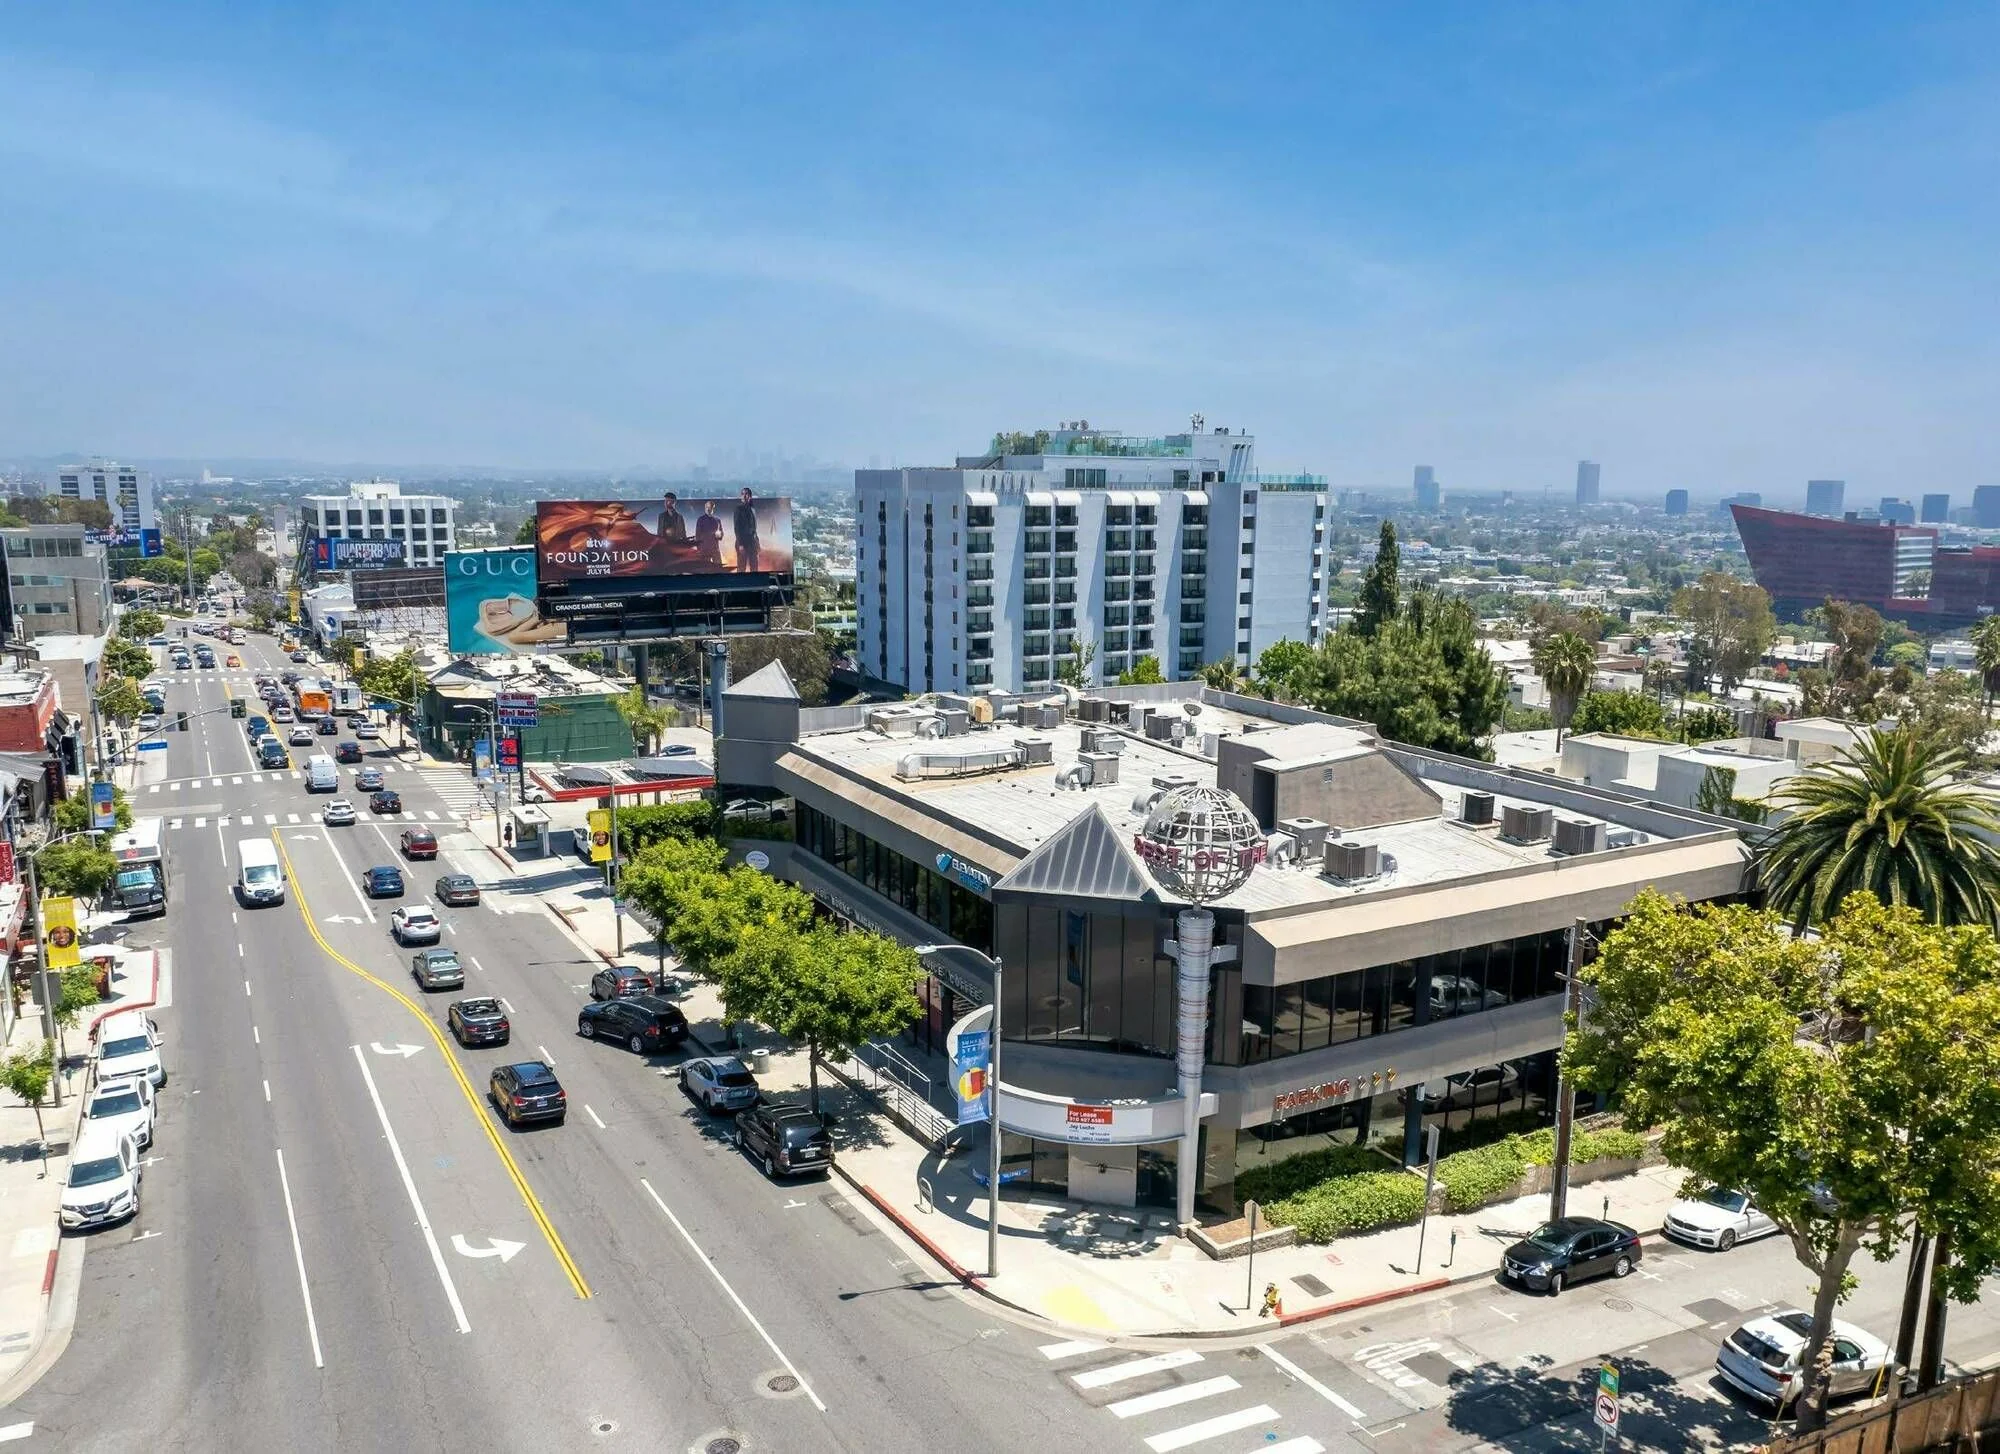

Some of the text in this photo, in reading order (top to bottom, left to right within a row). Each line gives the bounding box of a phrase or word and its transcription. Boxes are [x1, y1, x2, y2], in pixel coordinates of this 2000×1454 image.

[336, 543, 402, 560] QUARTERBACK
[547, 550, 649, 563] FOUNDATION
[603, 567, 611, 575] 14
[555, 604, 581, 612] ORANGE
[517, 709, 537, 718] Mart
[511, 718, 537, 726] HOURS
[1194, 849, 1228, 870] OF
[1237, 840, 1268, 867] THE
[951, 858, 992, 887] ELEVATION
[1274, 1079, 1350, 1111] PARKING
